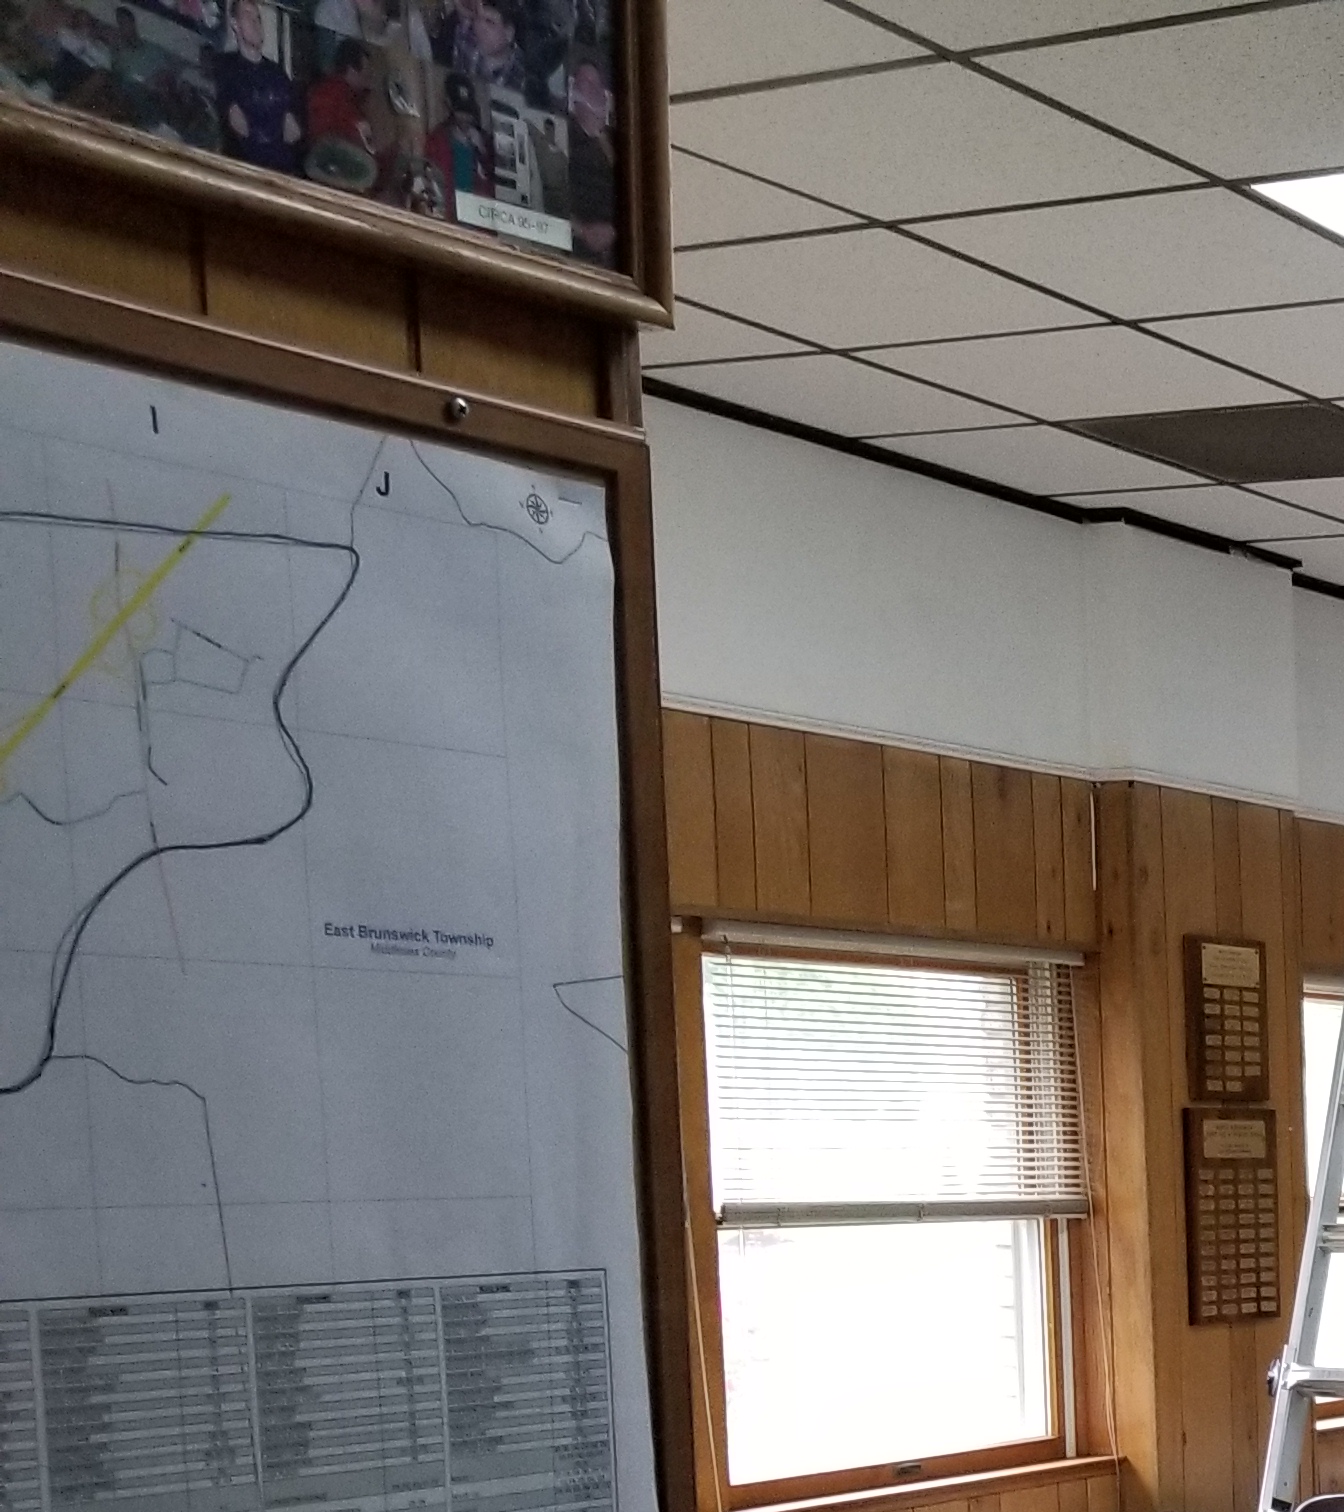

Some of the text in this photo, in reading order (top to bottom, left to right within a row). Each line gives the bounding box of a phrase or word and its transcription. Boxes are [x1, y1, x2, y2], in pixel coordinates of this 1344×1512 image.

[478, 204, 515, 226] CIRCA
[375, 472, 391, 499] J
[324, 922, 494, 950] East Brunswick Township
